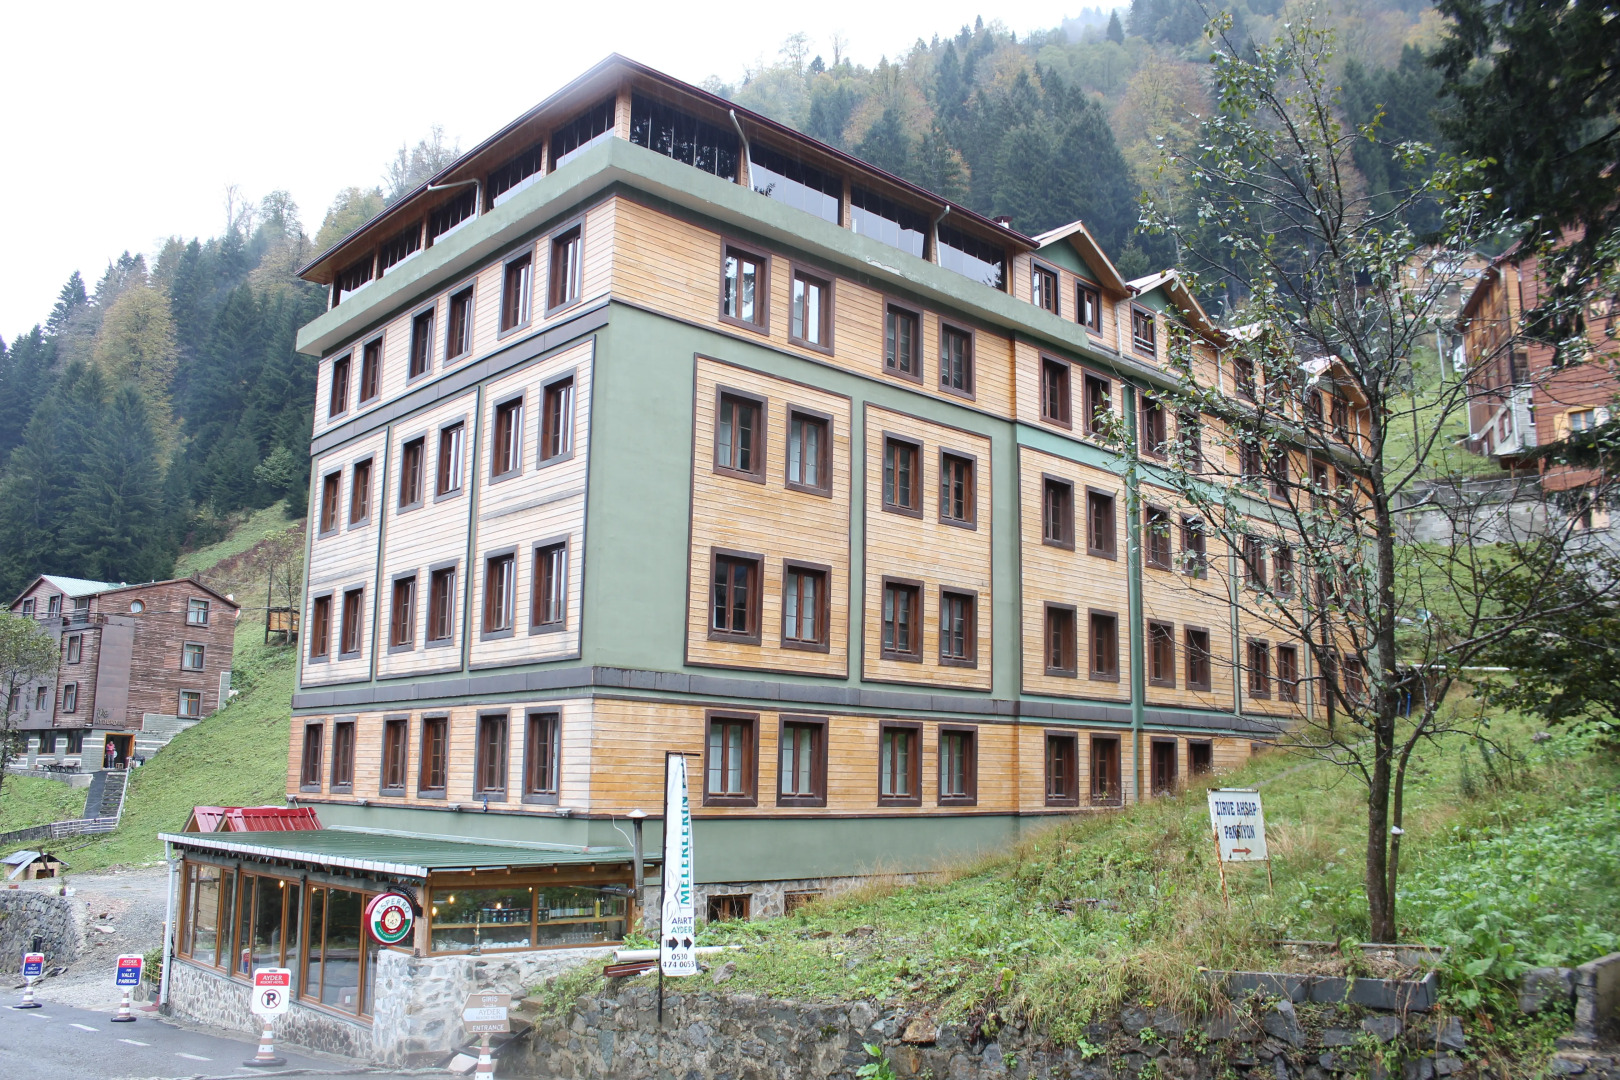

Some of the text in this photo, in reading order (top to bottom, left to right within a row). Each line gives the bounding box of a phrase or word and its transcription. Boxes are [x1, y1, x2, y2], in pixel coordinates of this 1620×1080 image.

[376, 898, 411, 914] ESPERRO
[671, 916, 693, 925] APART
[671, 926, 693, 934] AYDER
[679, 960, 695, 968] 0053
[472, 1024, 505, 1032] ENTRANCE
